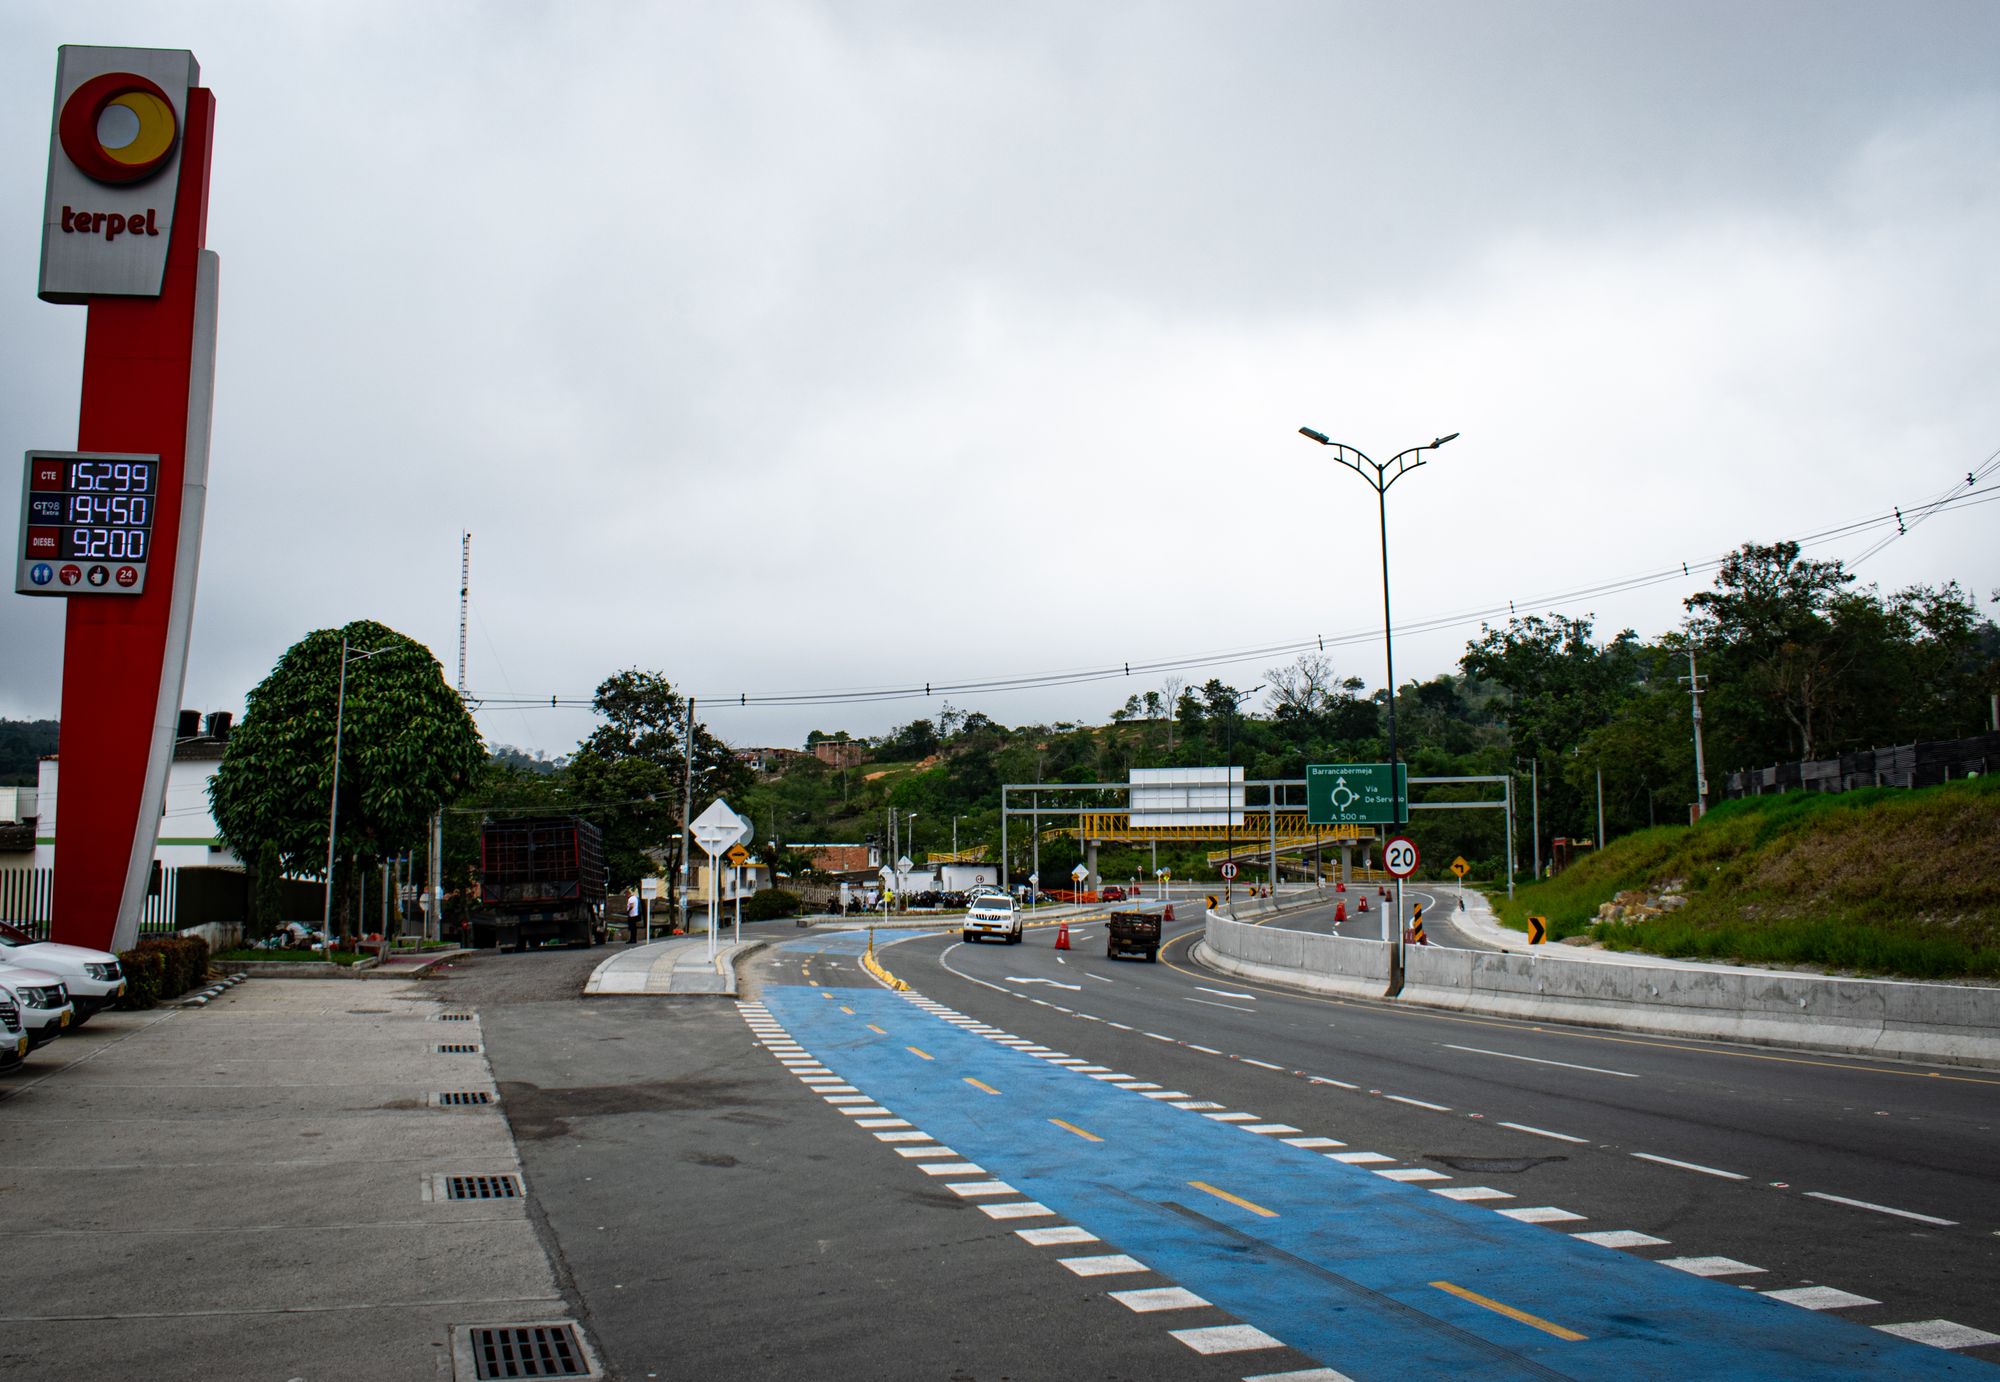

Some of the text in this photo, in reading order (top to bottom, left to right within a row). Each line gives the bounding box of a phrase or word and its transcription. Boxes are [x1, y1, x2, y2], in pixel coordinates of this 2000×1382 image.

[61, 205, 159, 241] terpel
[41, 471, 57, 481] CTE
[33, 496, 147, 525] GT98 19.450
[32, 529, 145, 558] DIESEL 9.200
[120, 570, 133, 579] 24
[1375, 795, 1405, 803] Servio
[1331, 813, 1338, 821] A
[1341, 813, 1357, 821] 500
[1390, 848, 1414, 867] 20
